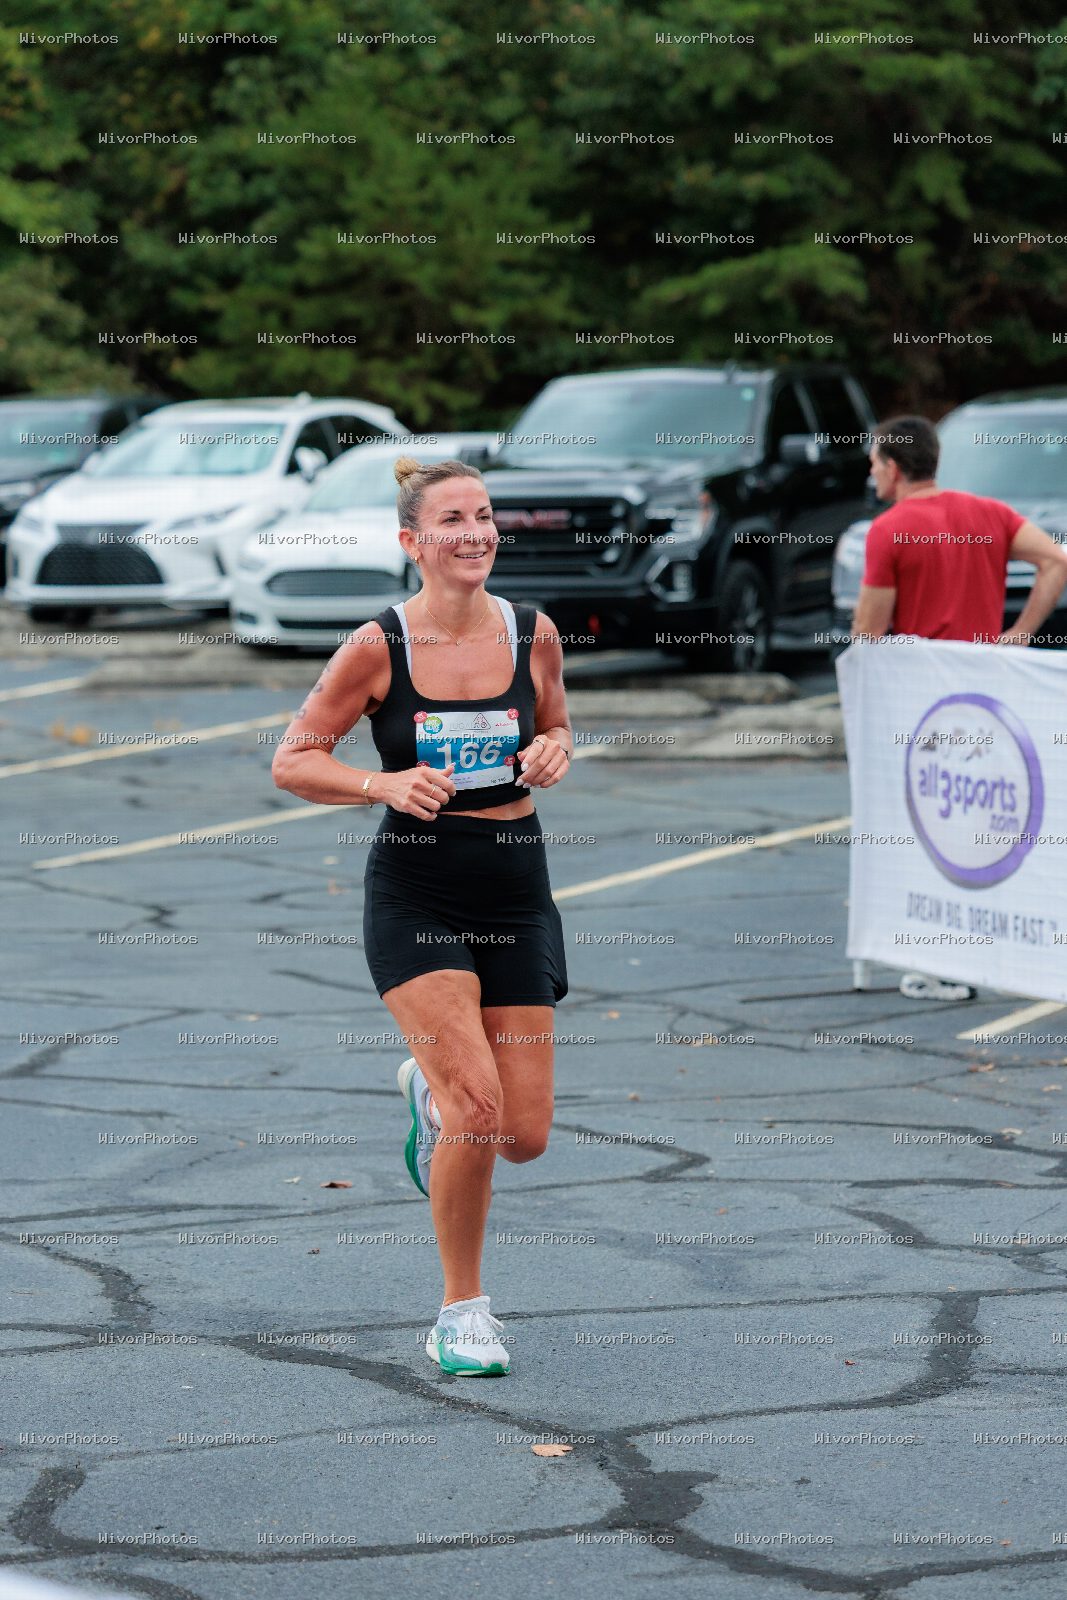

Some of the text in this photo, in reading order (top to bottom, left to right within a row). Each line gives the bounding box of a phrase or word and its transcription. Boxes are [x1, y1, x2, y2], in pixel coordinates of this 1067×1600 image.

[437, 741, 503, 768] 166
[918, 762, 1018, 820] all3sports
[906, 891, 943, 924] DREAM
[968, 905, 1009, 939] DREAM
